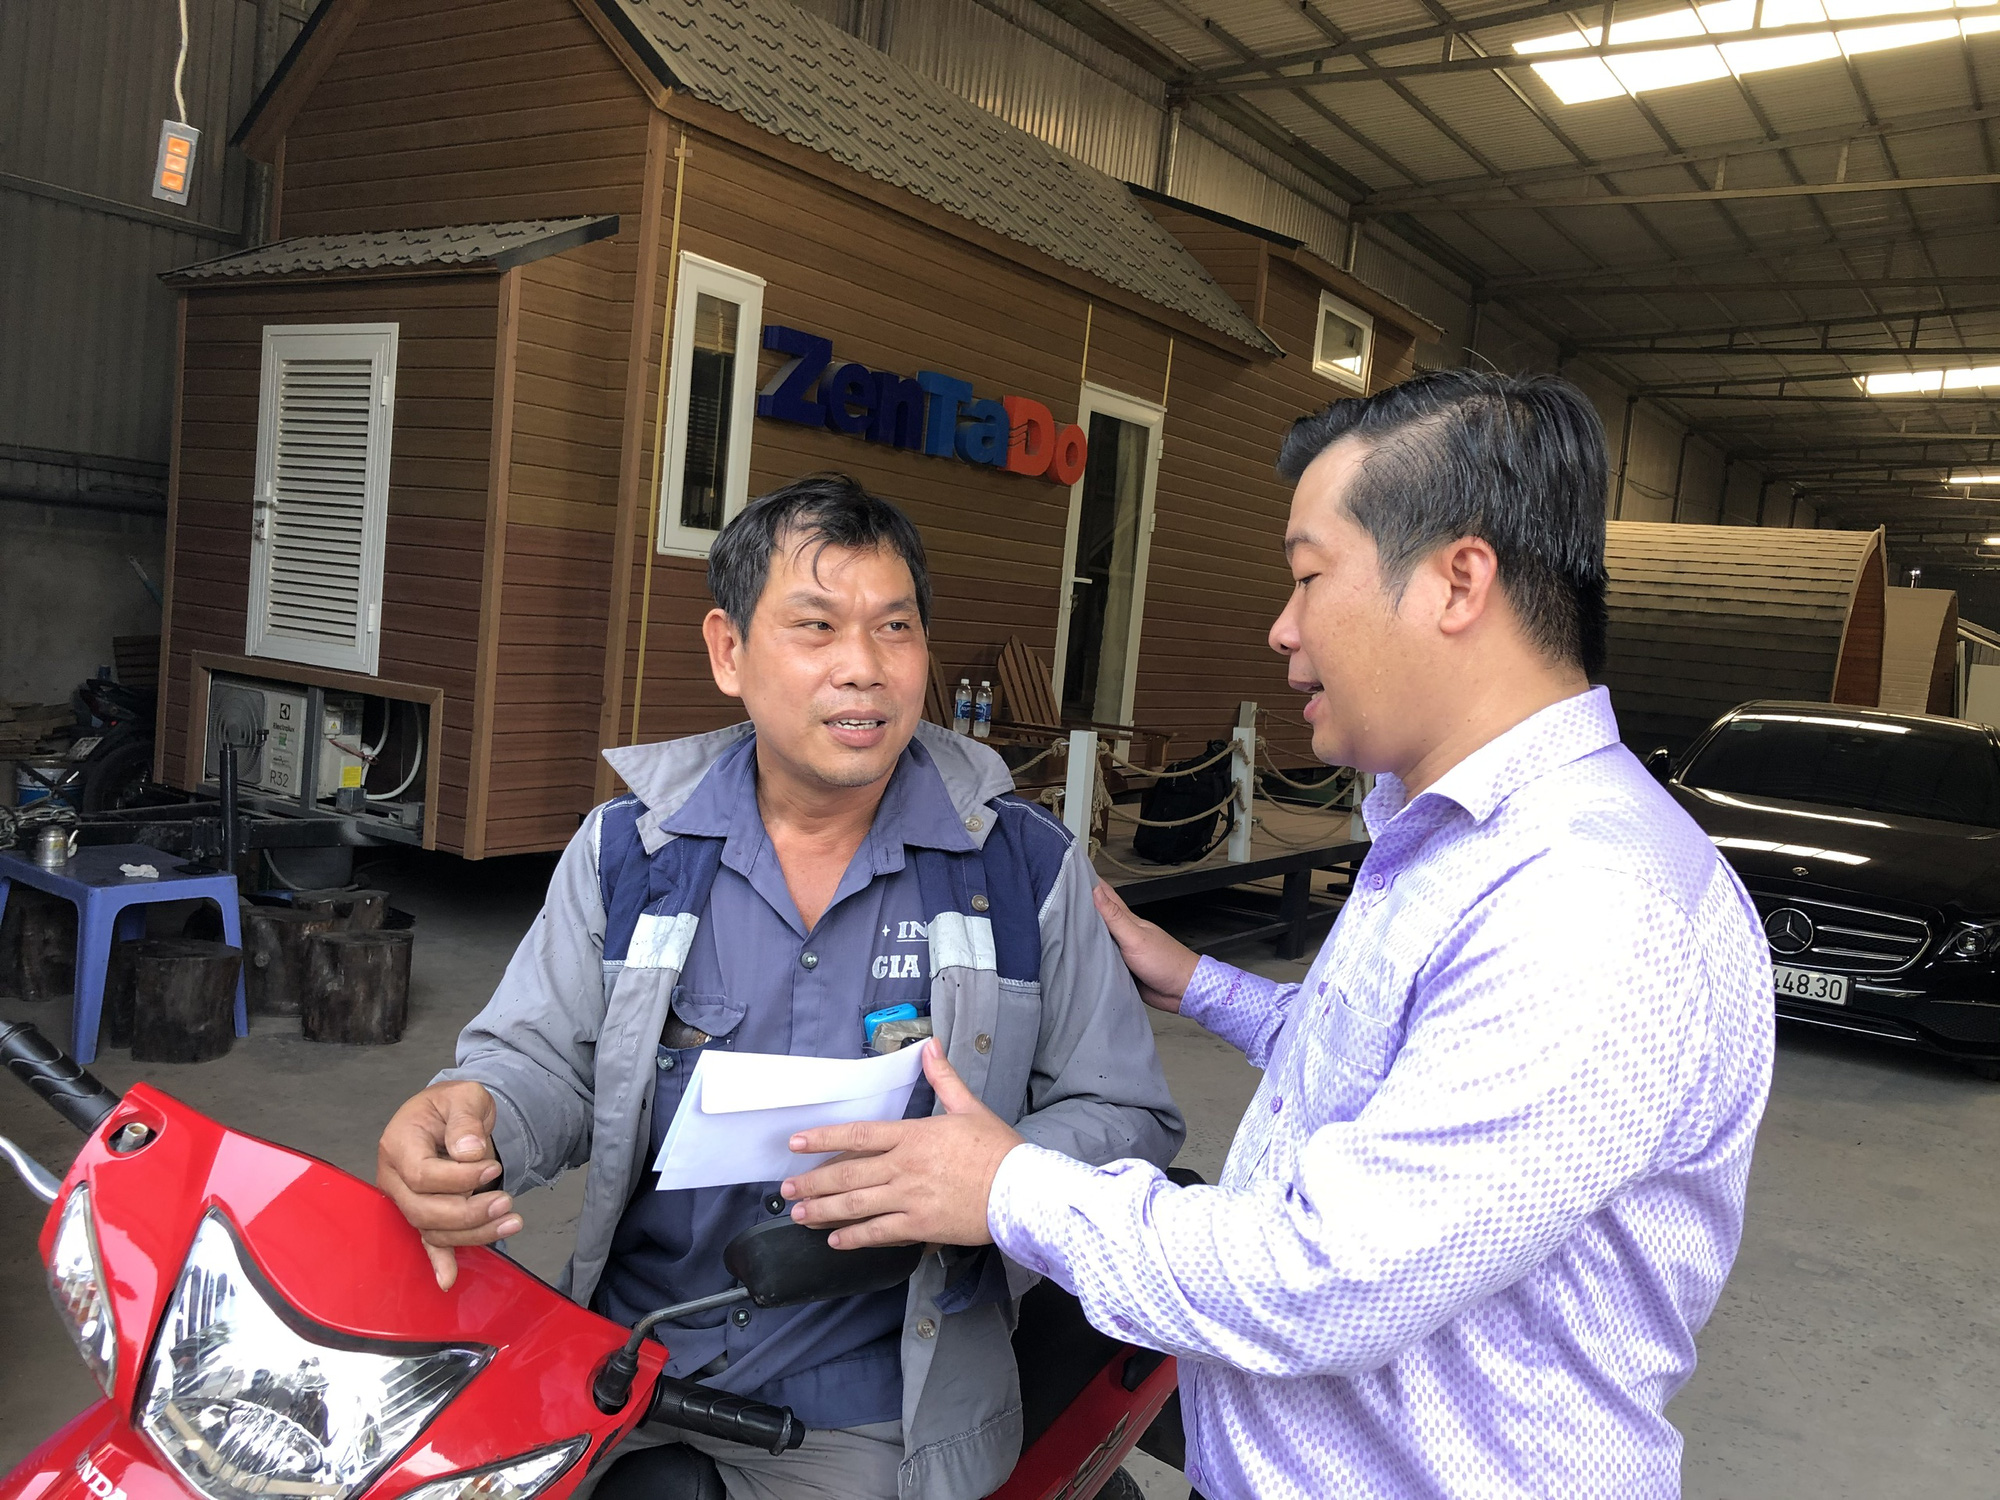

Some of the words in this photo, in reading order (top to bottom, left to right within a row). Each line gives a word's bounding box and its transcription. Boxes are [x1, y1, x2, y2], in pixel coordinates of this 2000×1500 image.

[757, 325, 1087, 485] ZenTaDo
[270, 770, 289, 788] R32
[872, 954, 920, 979] GIA
[75, 1453, 128, 1500] ONDA
